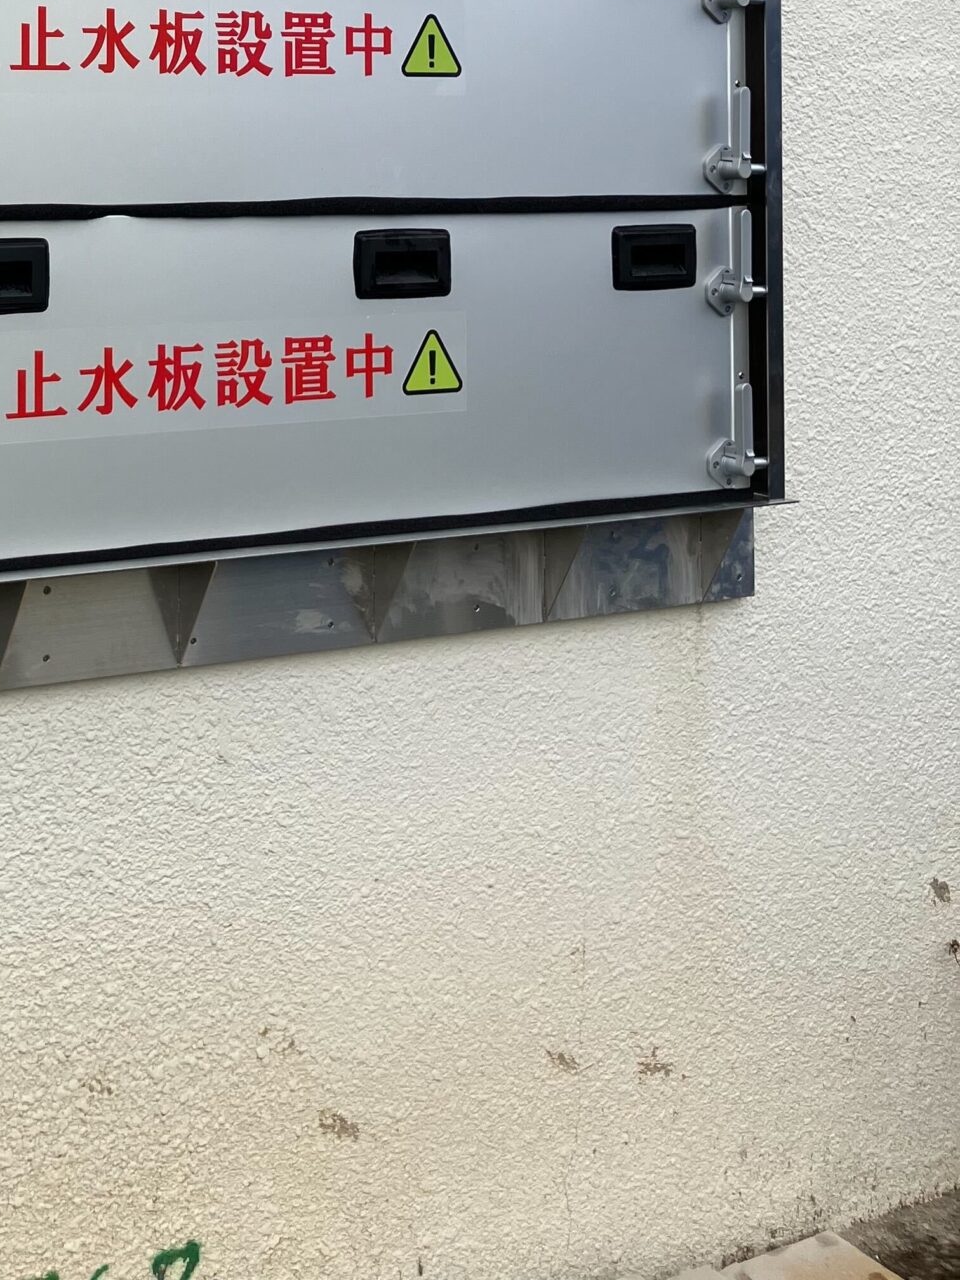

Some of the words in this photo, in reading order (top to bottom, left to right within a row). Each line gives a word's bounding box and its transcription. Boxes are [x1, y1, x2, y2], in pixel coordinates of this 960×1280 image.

[9, 5, 393, 77] 止水板設置中
[5, 332, 394, 420] 止水板設置中
